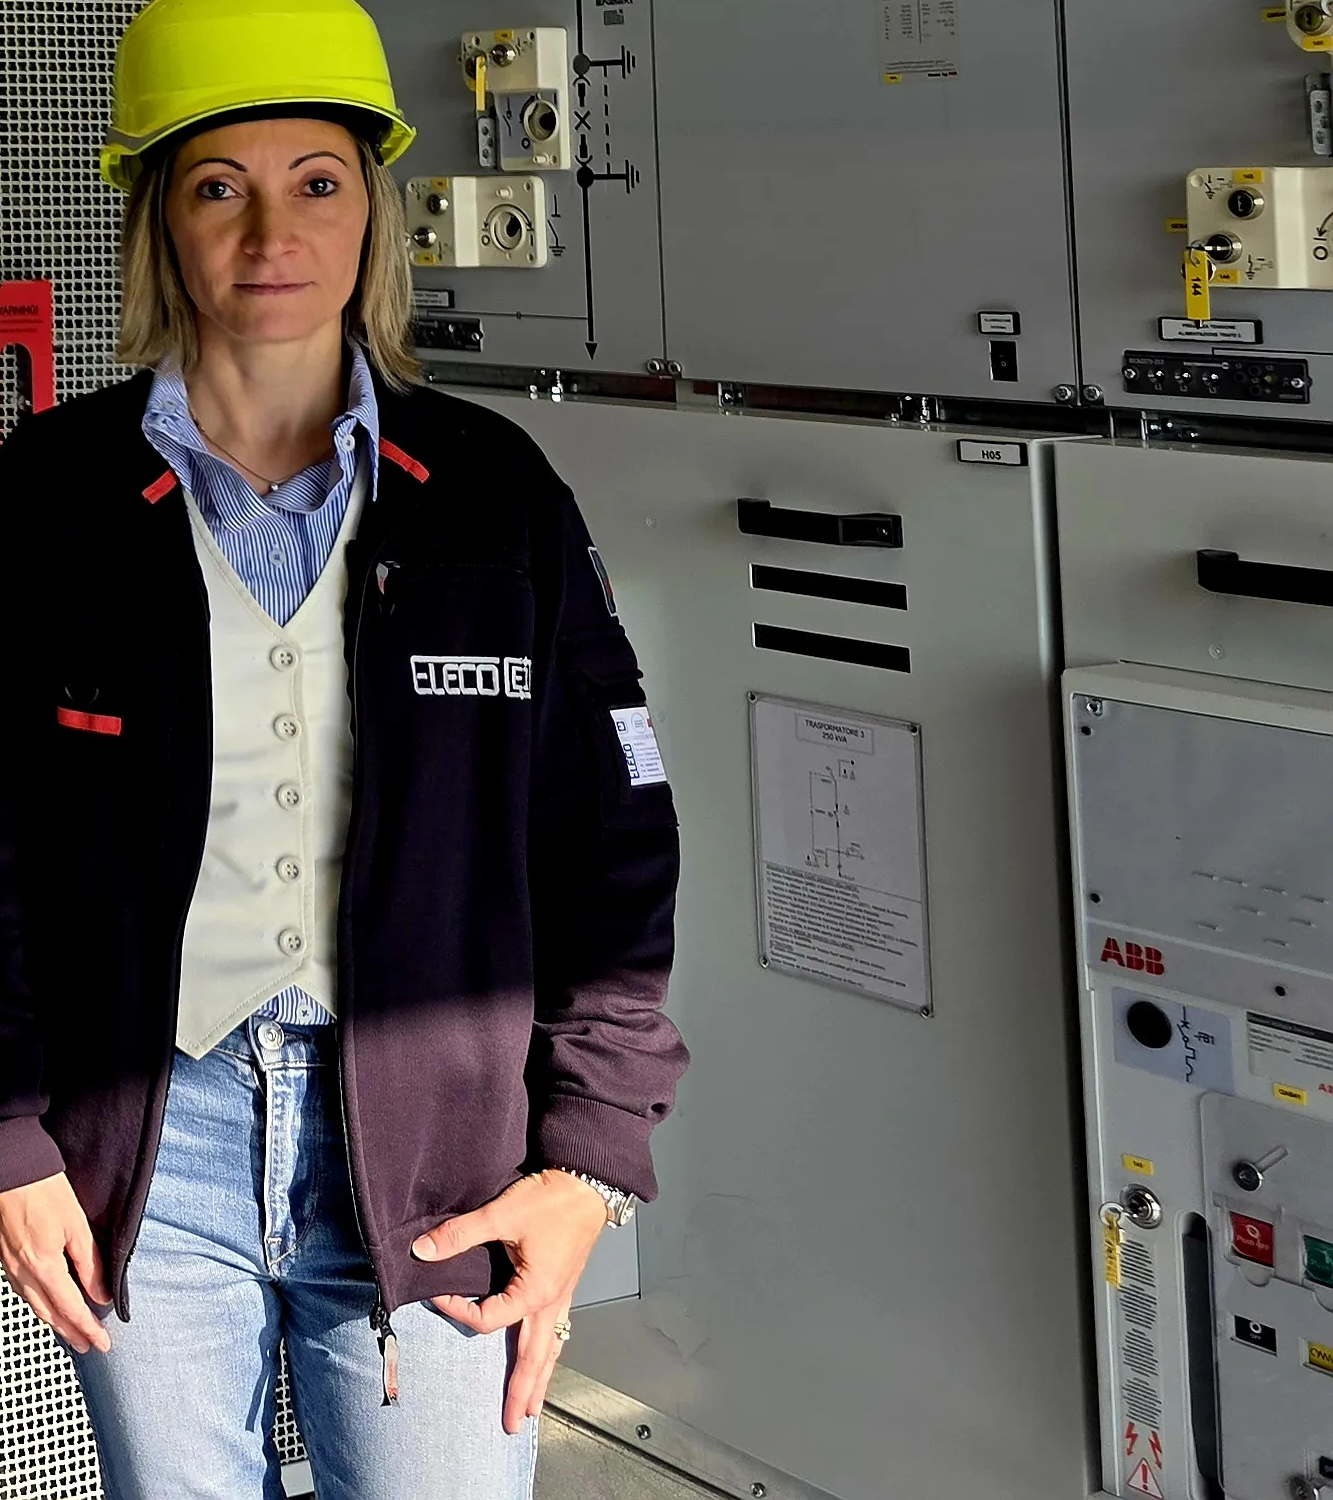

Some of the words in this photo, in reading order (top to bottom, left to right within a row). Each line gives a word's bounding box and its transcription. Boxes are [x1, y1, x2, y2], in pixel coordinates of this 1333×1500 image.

[1191, 276, 1202, 296] 144
[981, 450, 1002, 460] H05
[410, 655, 500, 696] ELECO
[805, 719, 859, 738] TRASFORMATORE
[1101, 937, 1164, 975] ABB
